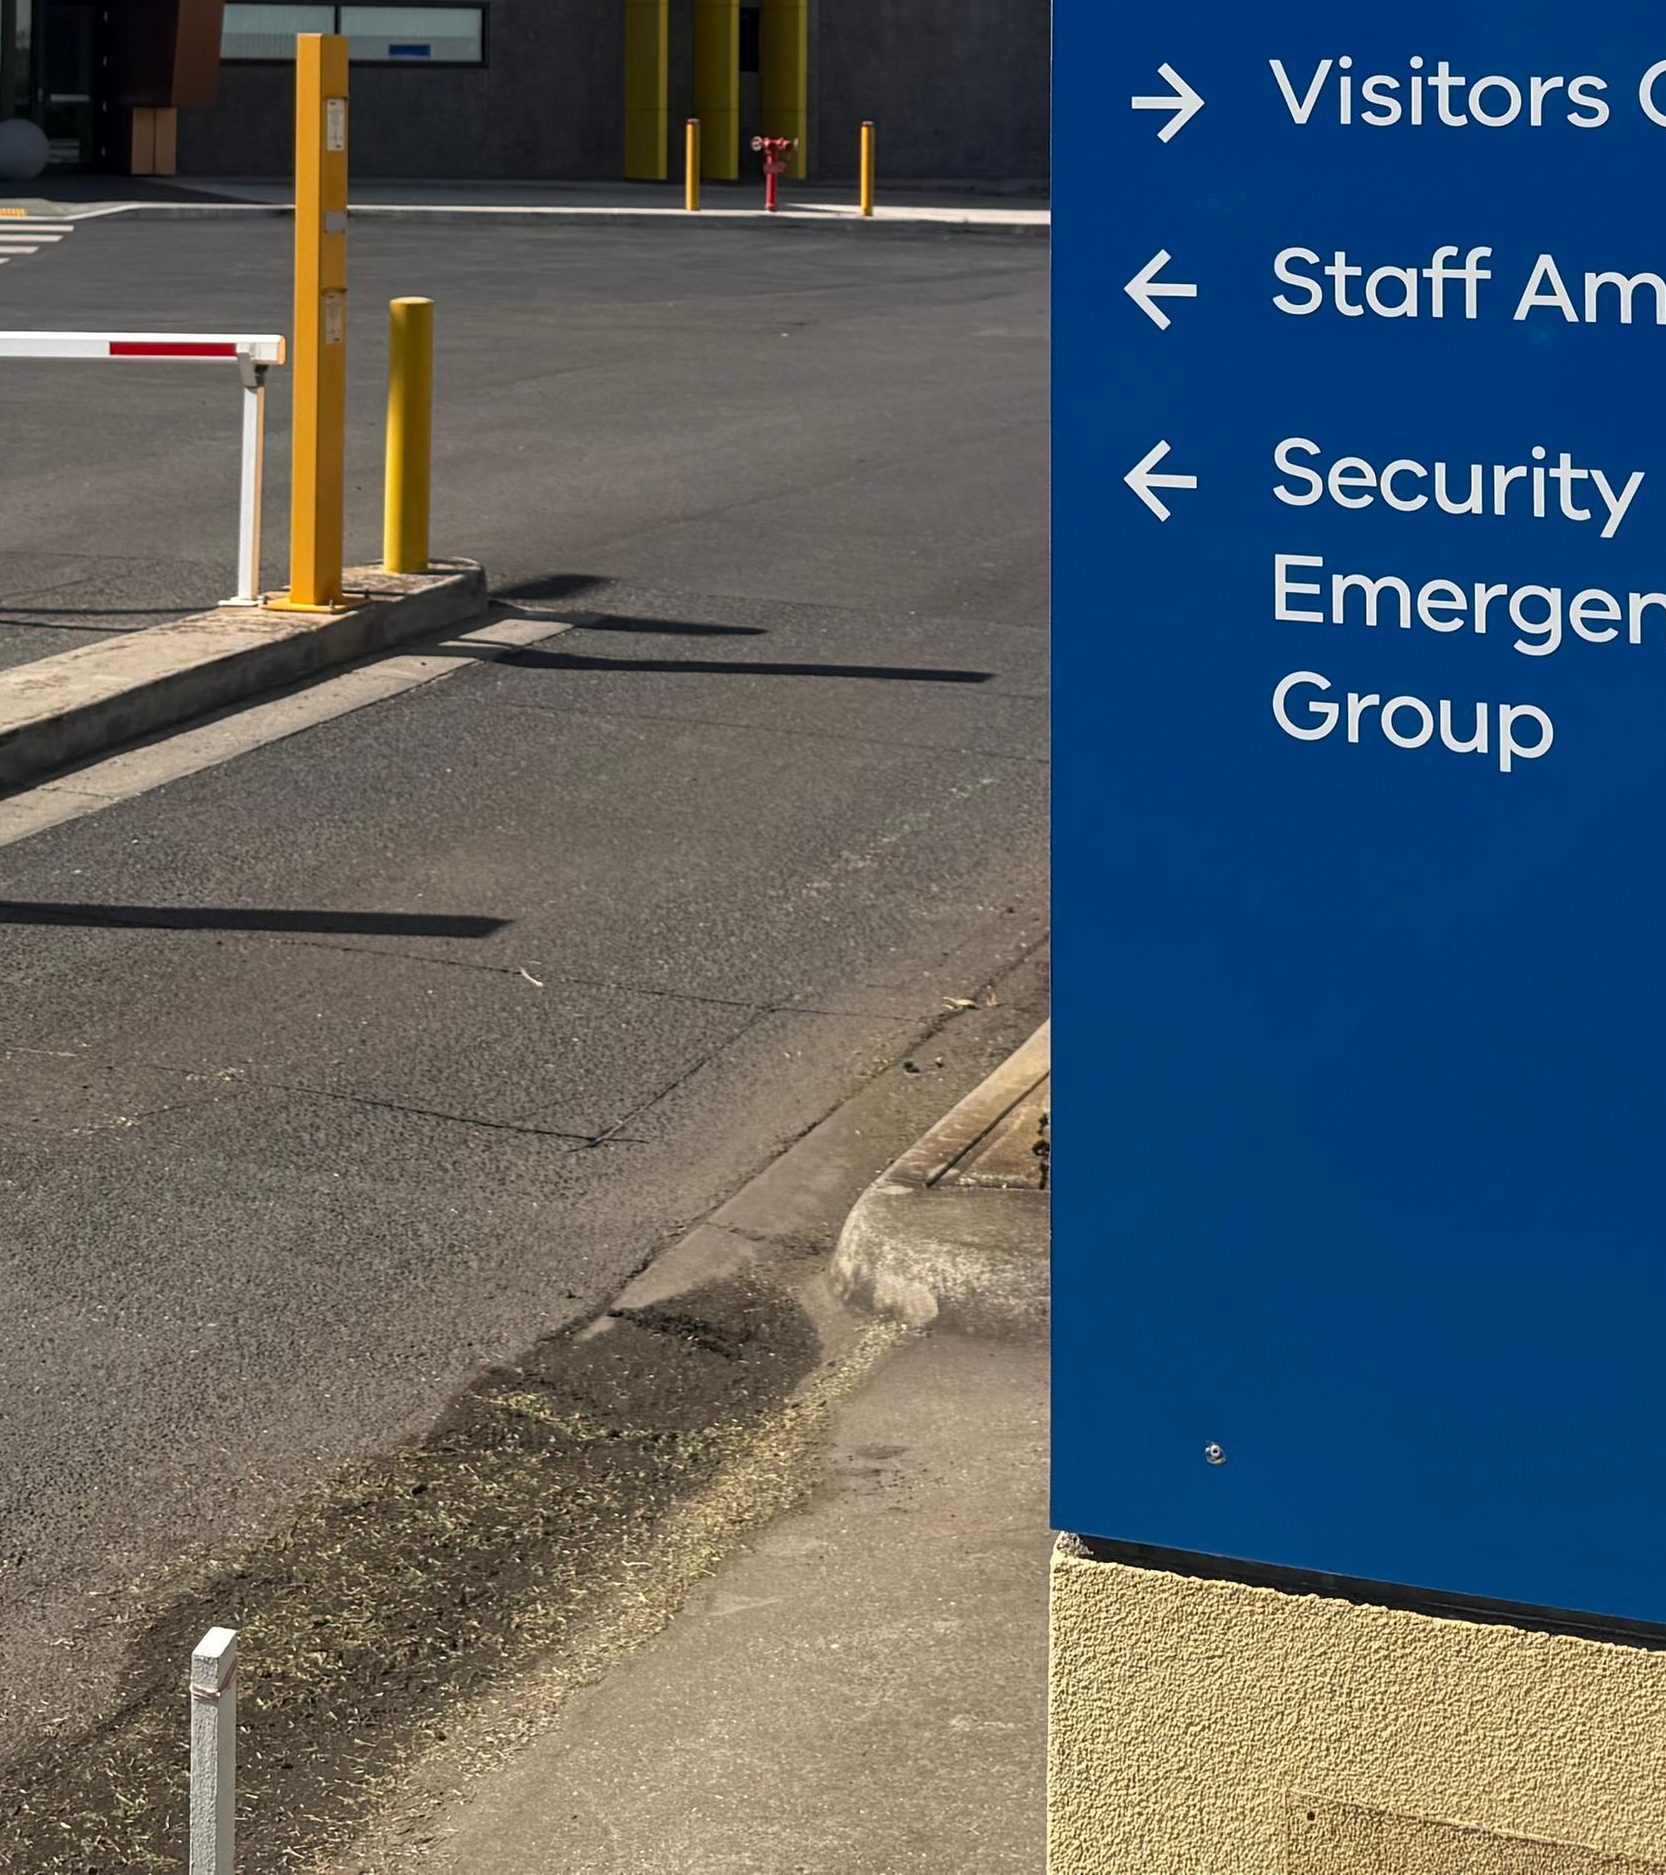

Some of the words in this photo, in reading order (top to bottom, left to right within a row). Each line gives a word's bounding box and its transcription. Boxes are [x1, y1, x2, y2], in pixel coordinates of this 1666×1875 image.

[1269, 56, 1609, 127] Visitors
[1273, 246, 1492, 318] Staff
[1274, 438, 1645, 538] Security
[1273, 671, 1553, 772] Group
